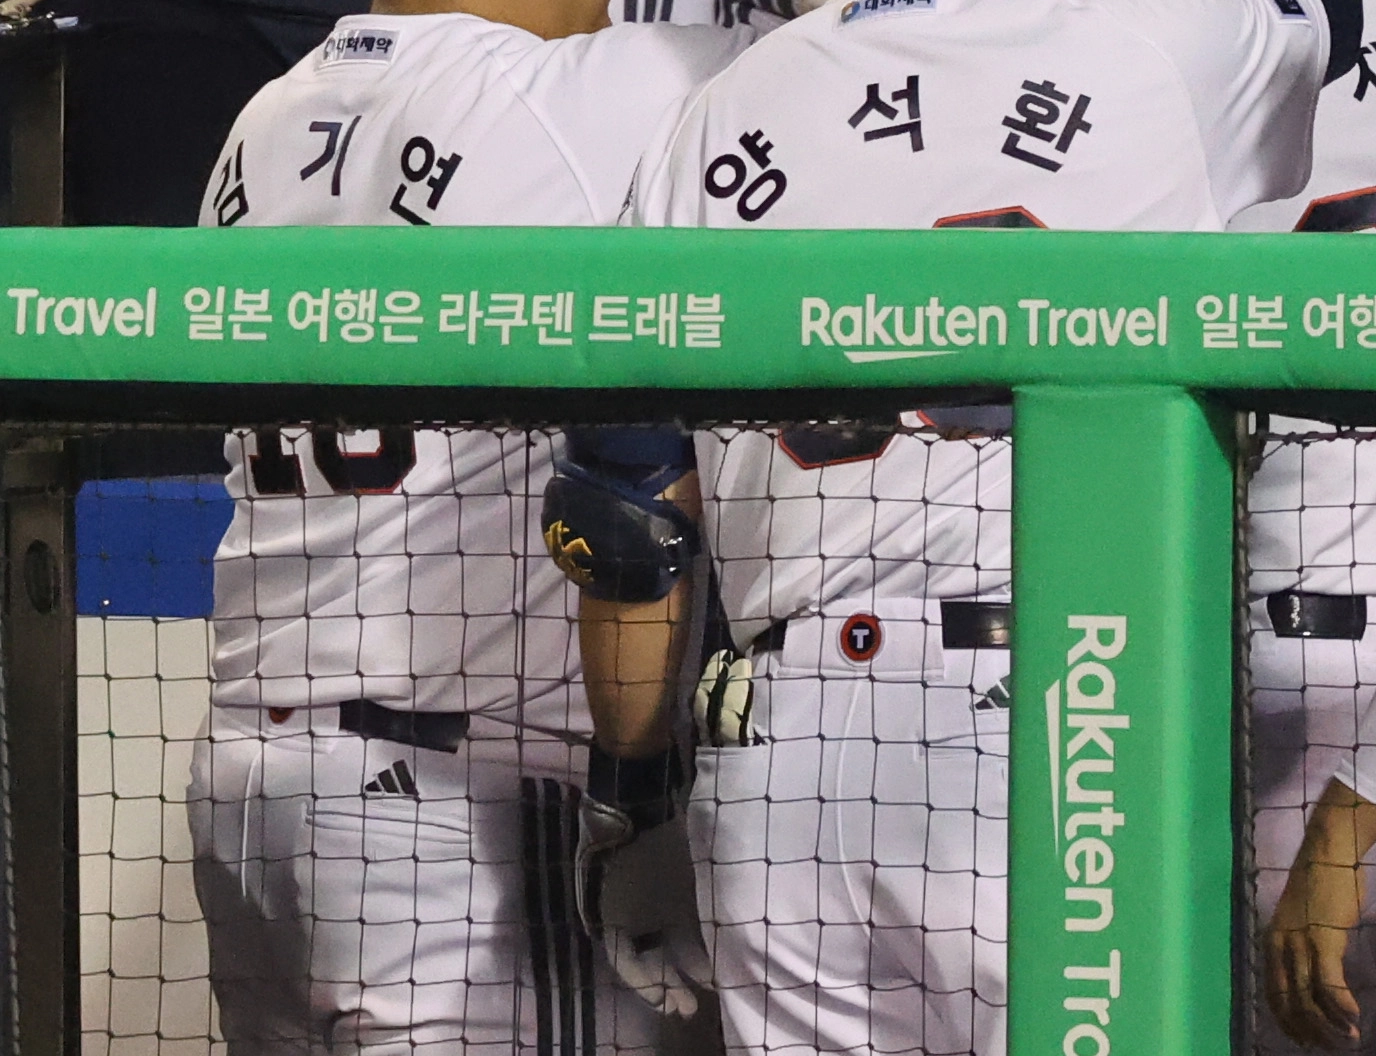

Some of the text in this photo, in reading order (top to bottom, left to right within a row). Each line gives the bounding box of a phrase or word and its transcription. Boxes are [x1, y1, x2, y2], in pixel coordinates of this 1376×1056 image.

[703, 74, 1092, 222] 양석환
[8, 287, 726, 349] Travel 일본 여행은 라쿠텐 트래블
[802, 294, 1008, 348] Rakuten
[1019, 297, 1169, 347] Travel
[1197, 294, 1289, 349] 일본
[1064, 616, 1131, 933] Rakuten
